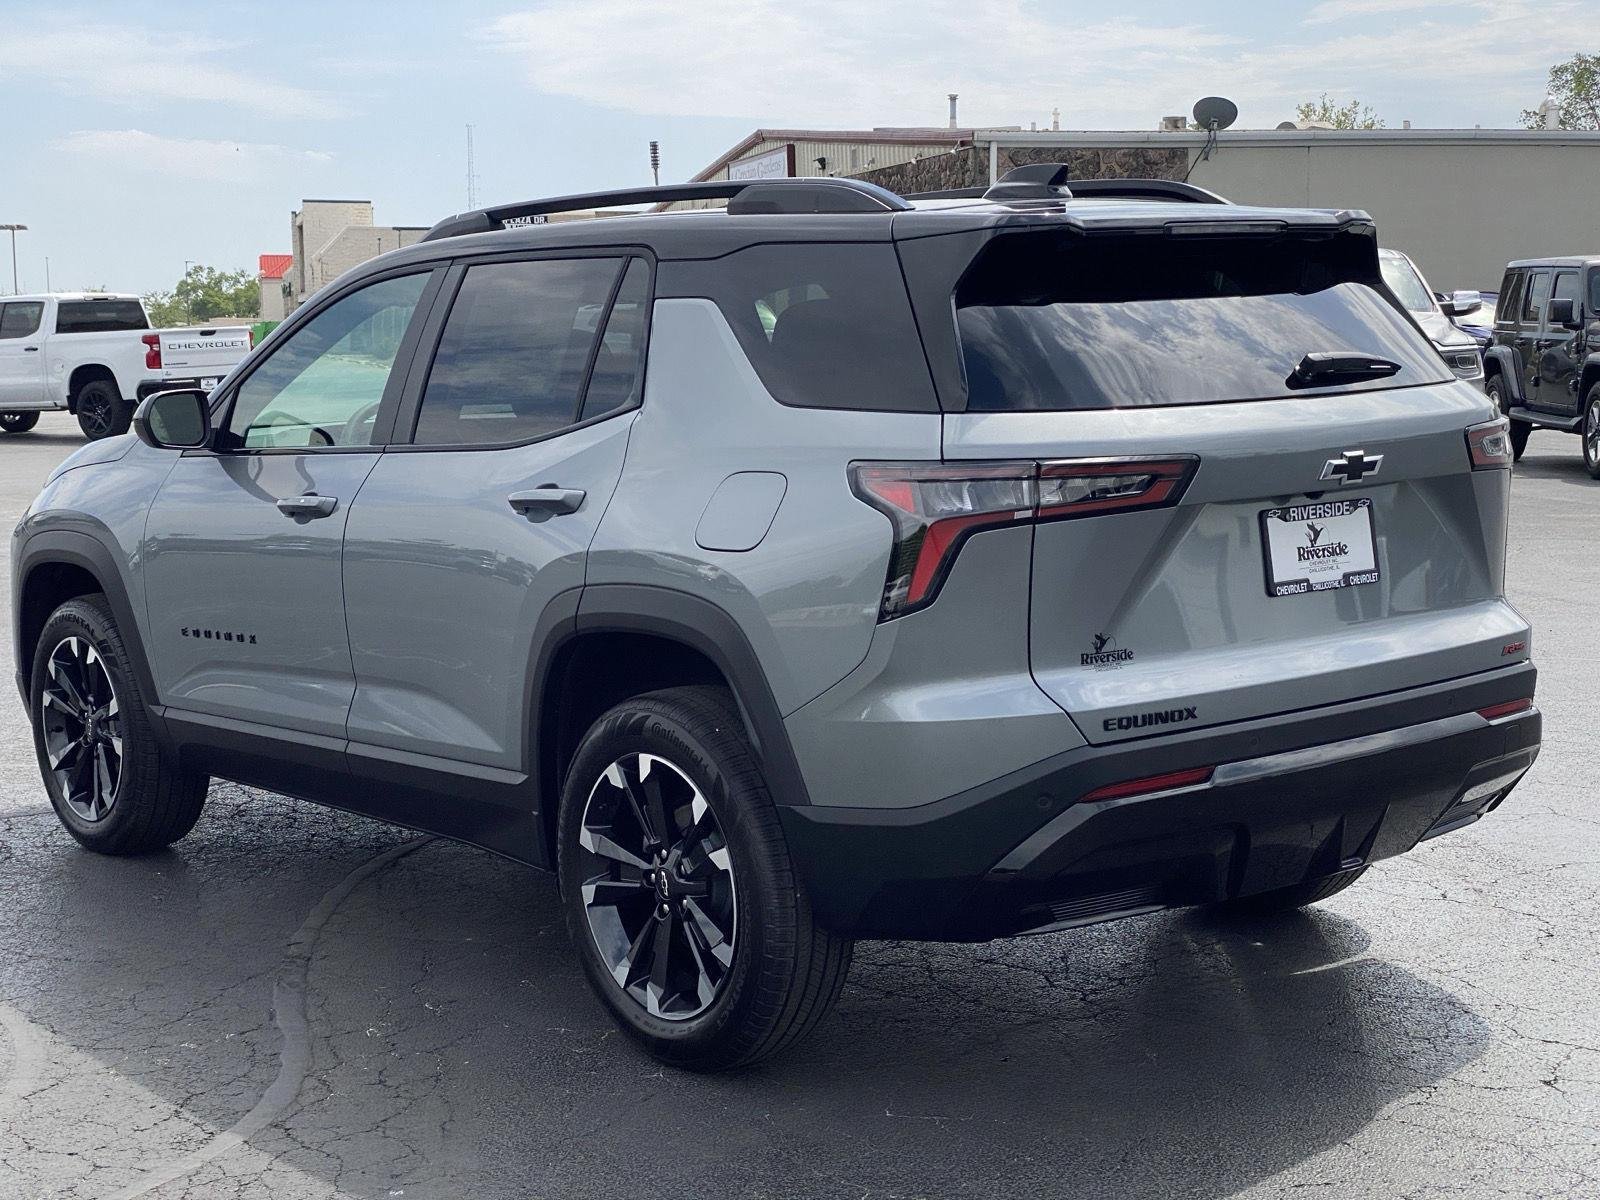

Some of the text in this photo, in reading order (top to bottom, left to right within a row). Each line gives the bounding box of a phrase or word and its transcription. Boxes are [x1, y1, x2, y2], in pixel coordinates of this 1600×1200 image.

[168, 340, 245, 350] CHEVROLET
[1289, 501, 1351, 521] RIVERSIDE
[1297, 542, 1349, 561] Riverside
[1276, 582, 1308, 596] CHEVROLET
[1349, 572, 1379, 586] CHEVROLET
[181, 627, 257, 644] EQUINOX
[1080, 649, 1134, 665] Riverside
[1103, 706, 1198, 731] EQUINOX
